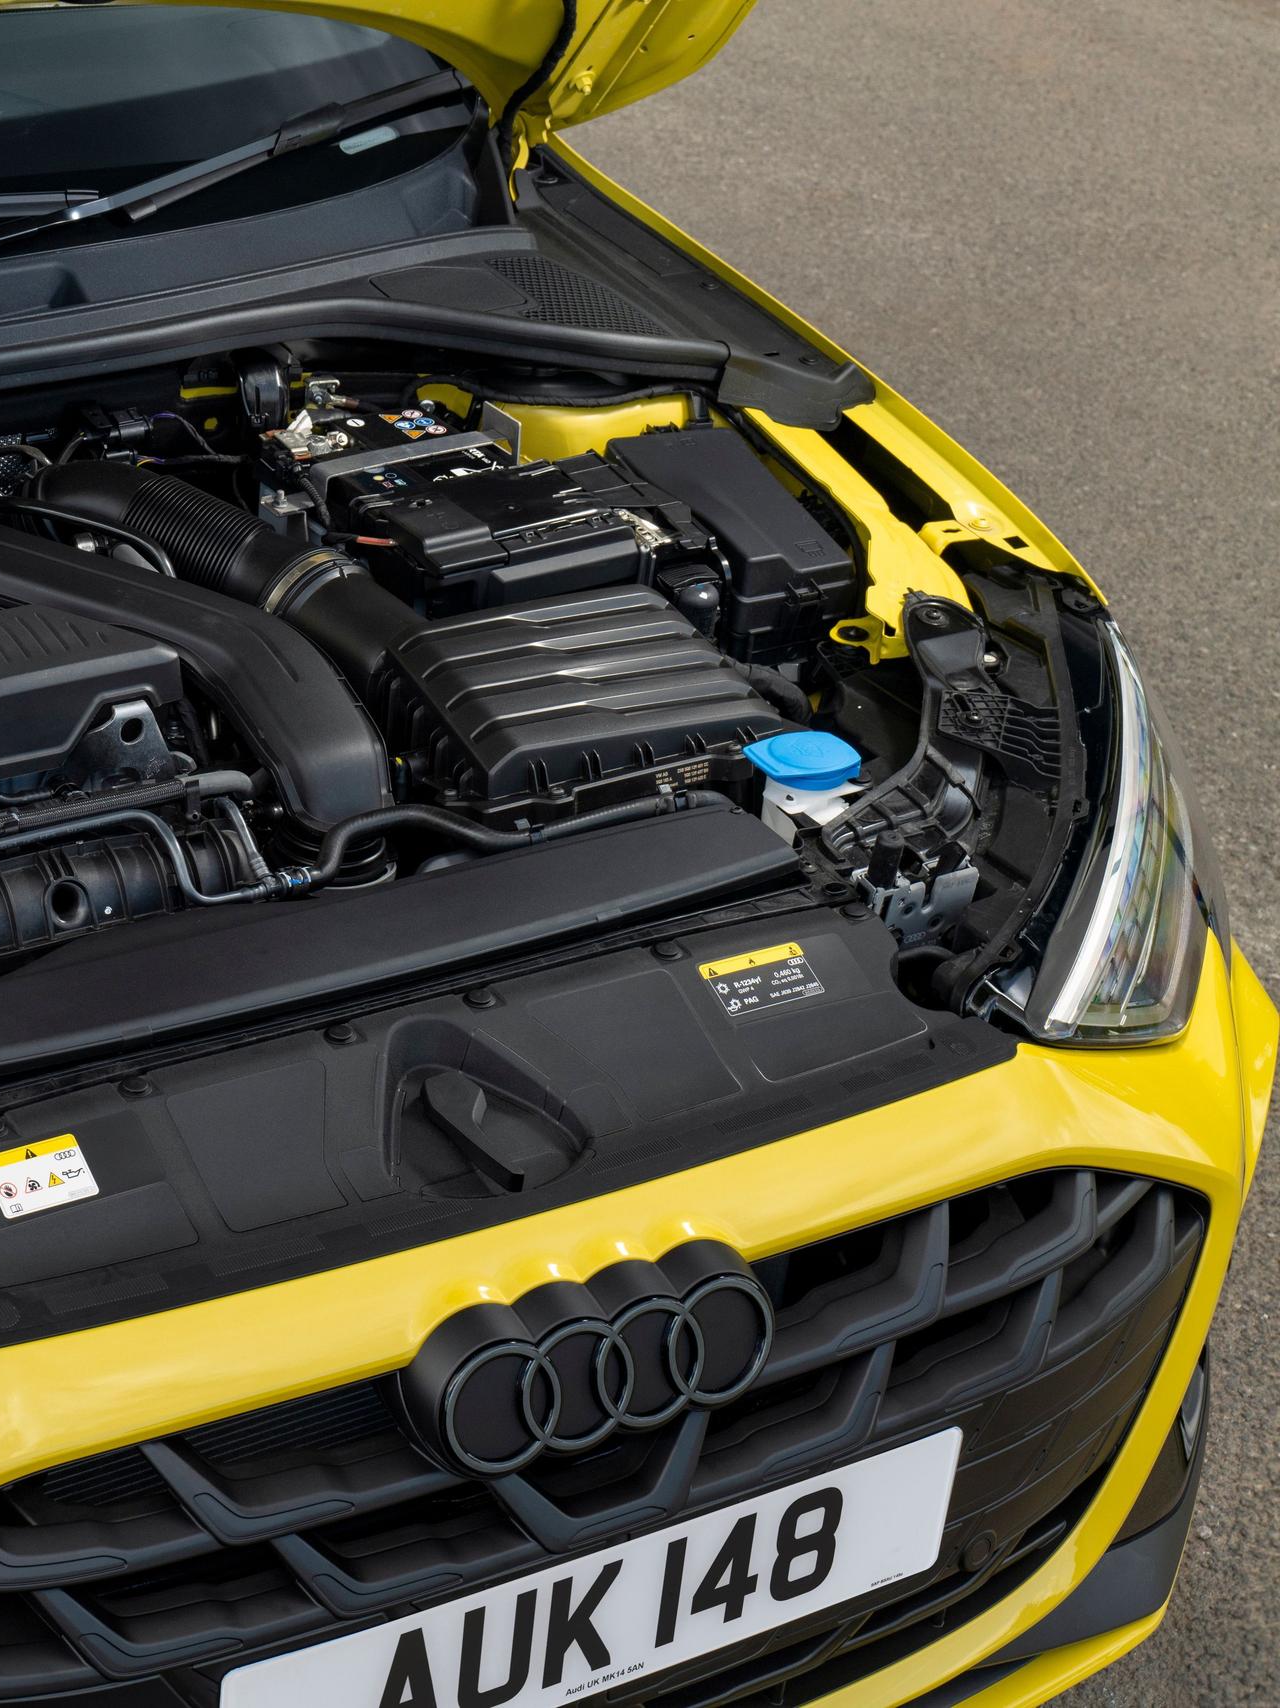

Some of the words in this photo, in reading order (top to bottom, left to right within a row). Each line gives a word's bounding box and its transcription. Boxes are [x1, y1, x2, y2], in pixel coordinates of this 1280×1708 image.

[733, 976, 762, 989] R-1234yf
[743, 995, 760, 1005] PAG
[378, 1558, 624, 1708] AUK
[654, 1486, 844, 1649] 148
[565, 1683, 586, 1697] Audi
[586, 1677, 600, 1689] UK
[601, 1668, 625, 1683] MK14
[626, 1661, 645, 1674] 5AN
